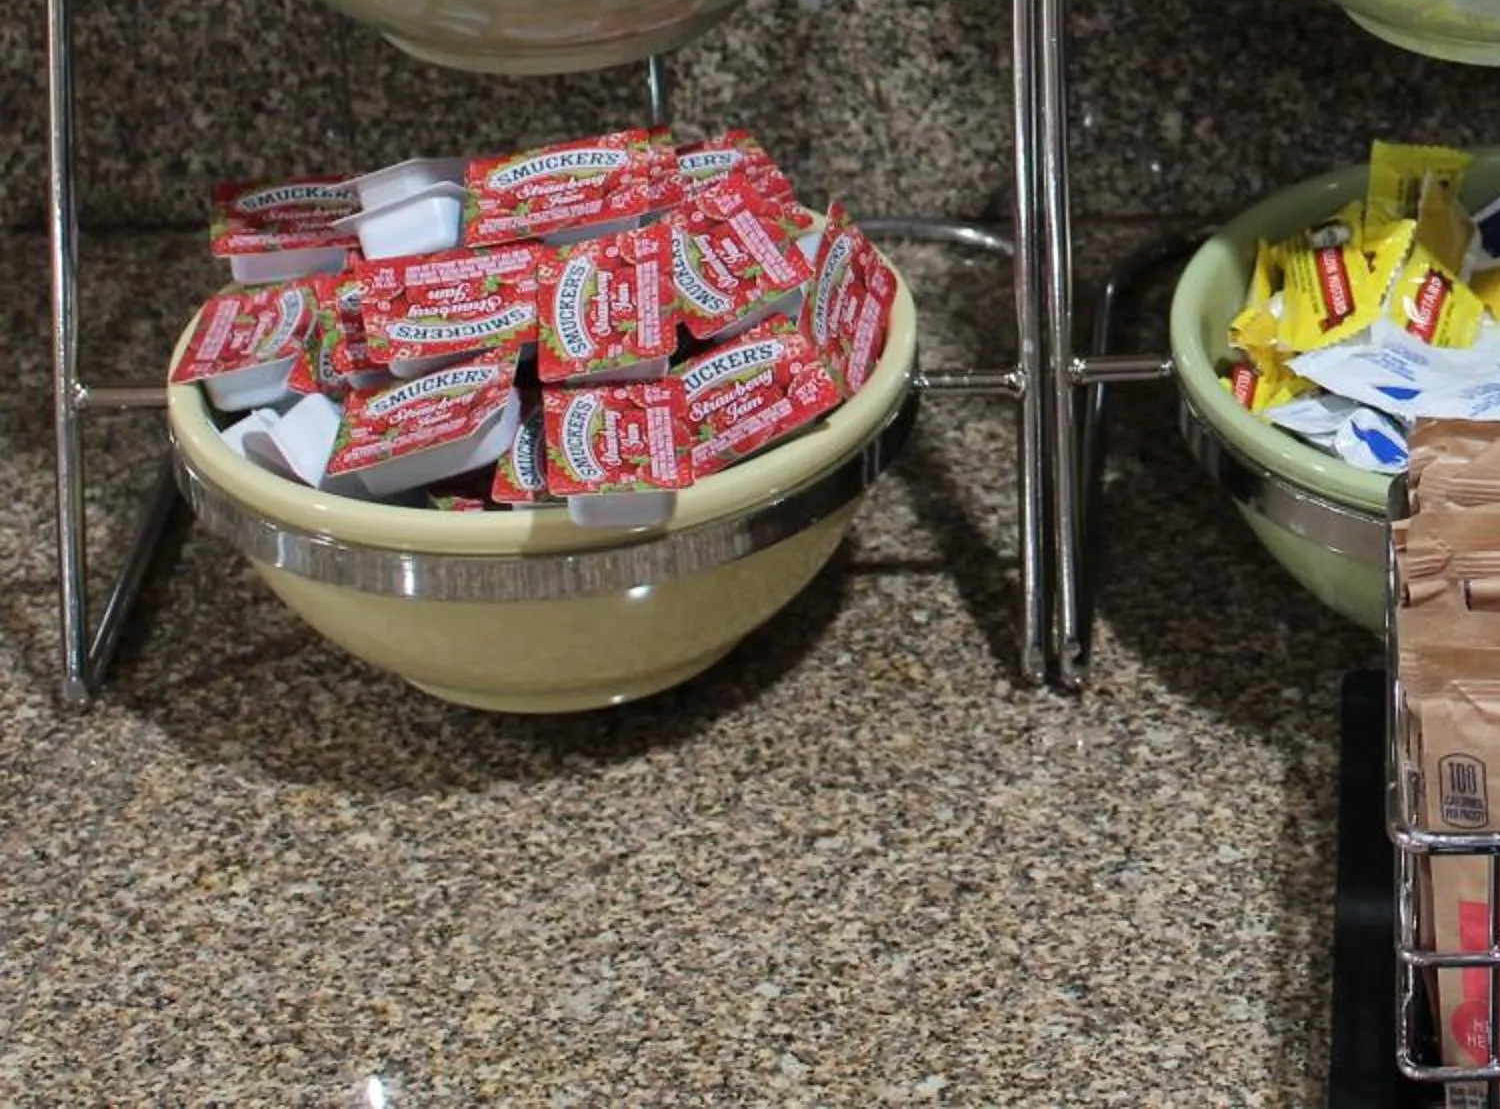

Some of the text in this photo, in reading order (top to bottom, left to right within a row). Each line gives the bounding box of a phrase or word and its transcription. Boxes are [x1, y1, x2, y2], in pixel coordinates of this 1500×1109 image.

[497, 151, 620, 187] SMUCKER'S
[558, 264, 587, 354] SMUCKER'S
[1327, 272, 1348, 316] MUSTARD
[397, 309, 526, 339] SMUCKER'S
[373, 368, 493, 413] SMUCKER'S
[689, 365, 774, 423] Strawberry
[725, 394, 764, 424] Jam
[565, 399, 598, 477] SMUCKER'S
[1448, 761, 1477, 795] 100
